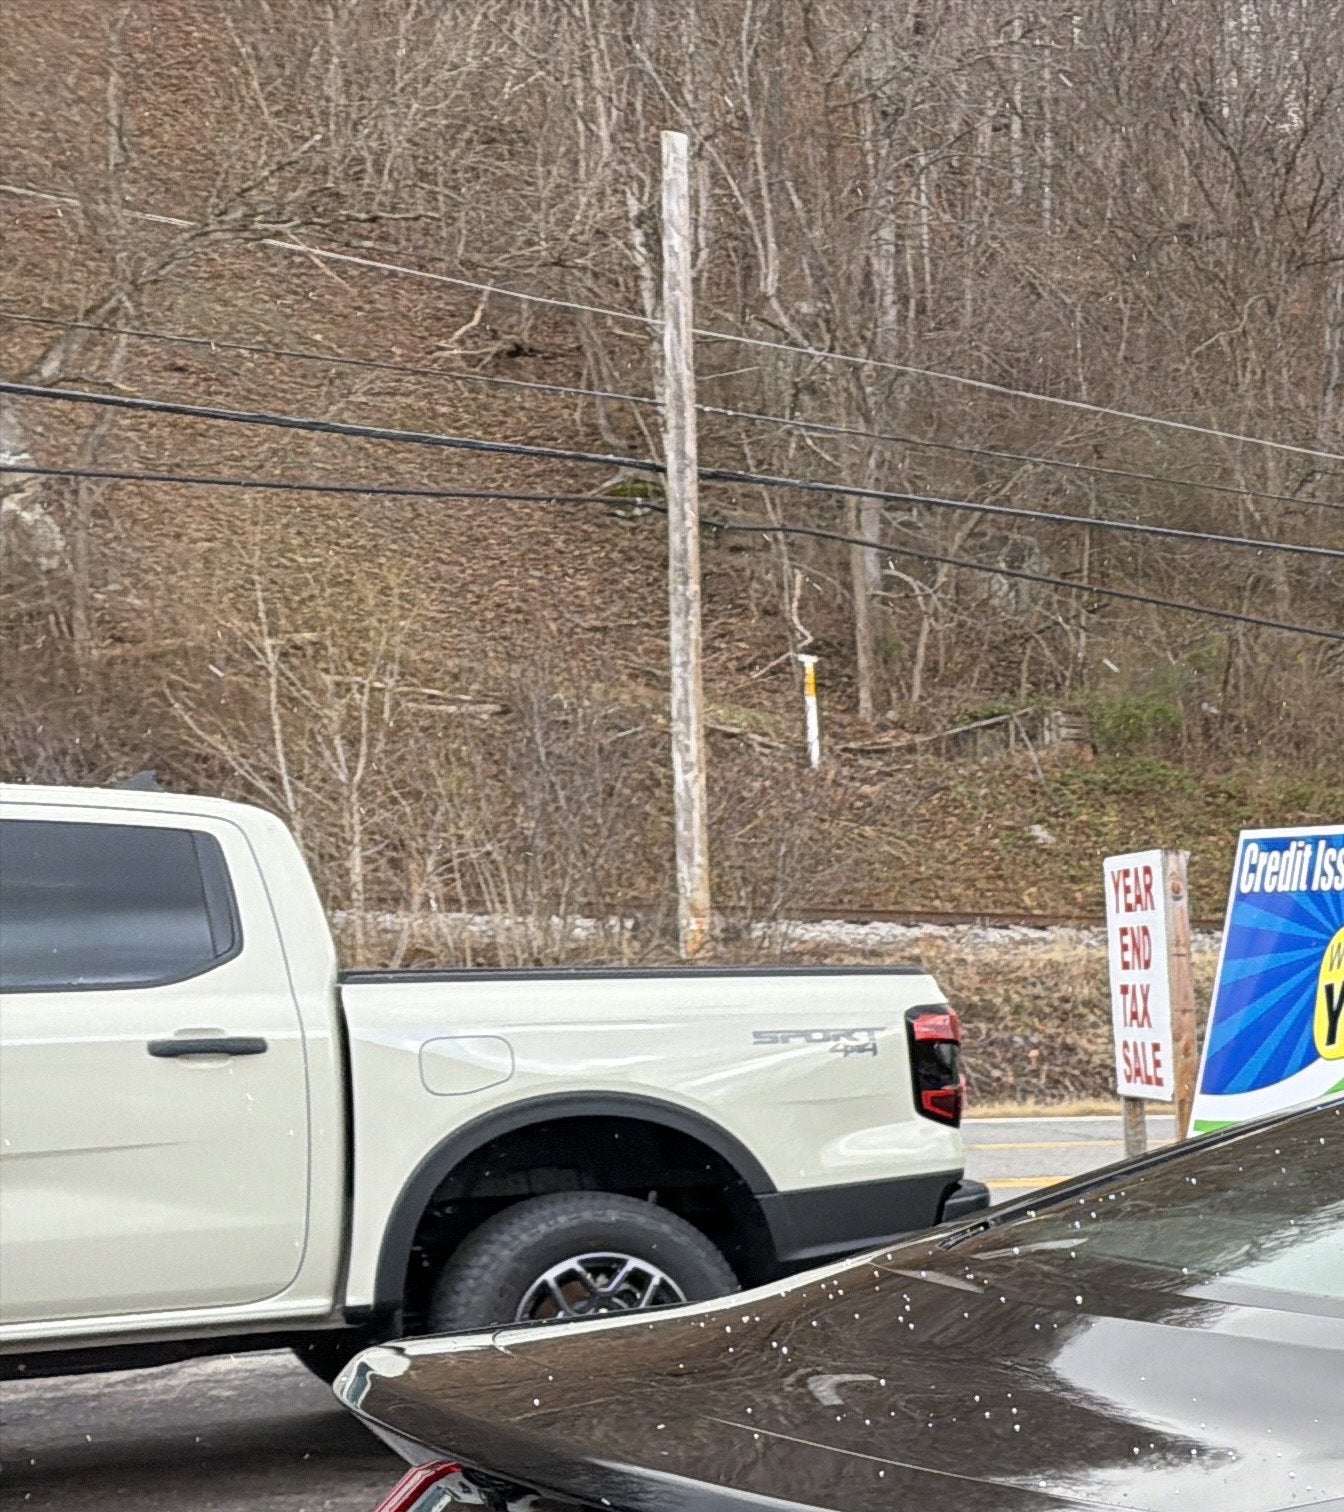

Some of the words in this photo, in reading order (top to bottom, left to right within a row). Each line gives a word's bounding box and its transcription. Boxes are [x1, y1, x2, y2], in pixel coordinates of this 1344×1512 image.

[1110, 865, 1156, 914] YEAR
[1239, 841, 1312, 894] Credit
[1119, 925, 1152, 971] END
[1120, 983, 1151, 1029] TAX
[752, 1026, 887, 1045] SPORT
[1122, 1041, 1164, 1088] SALE
